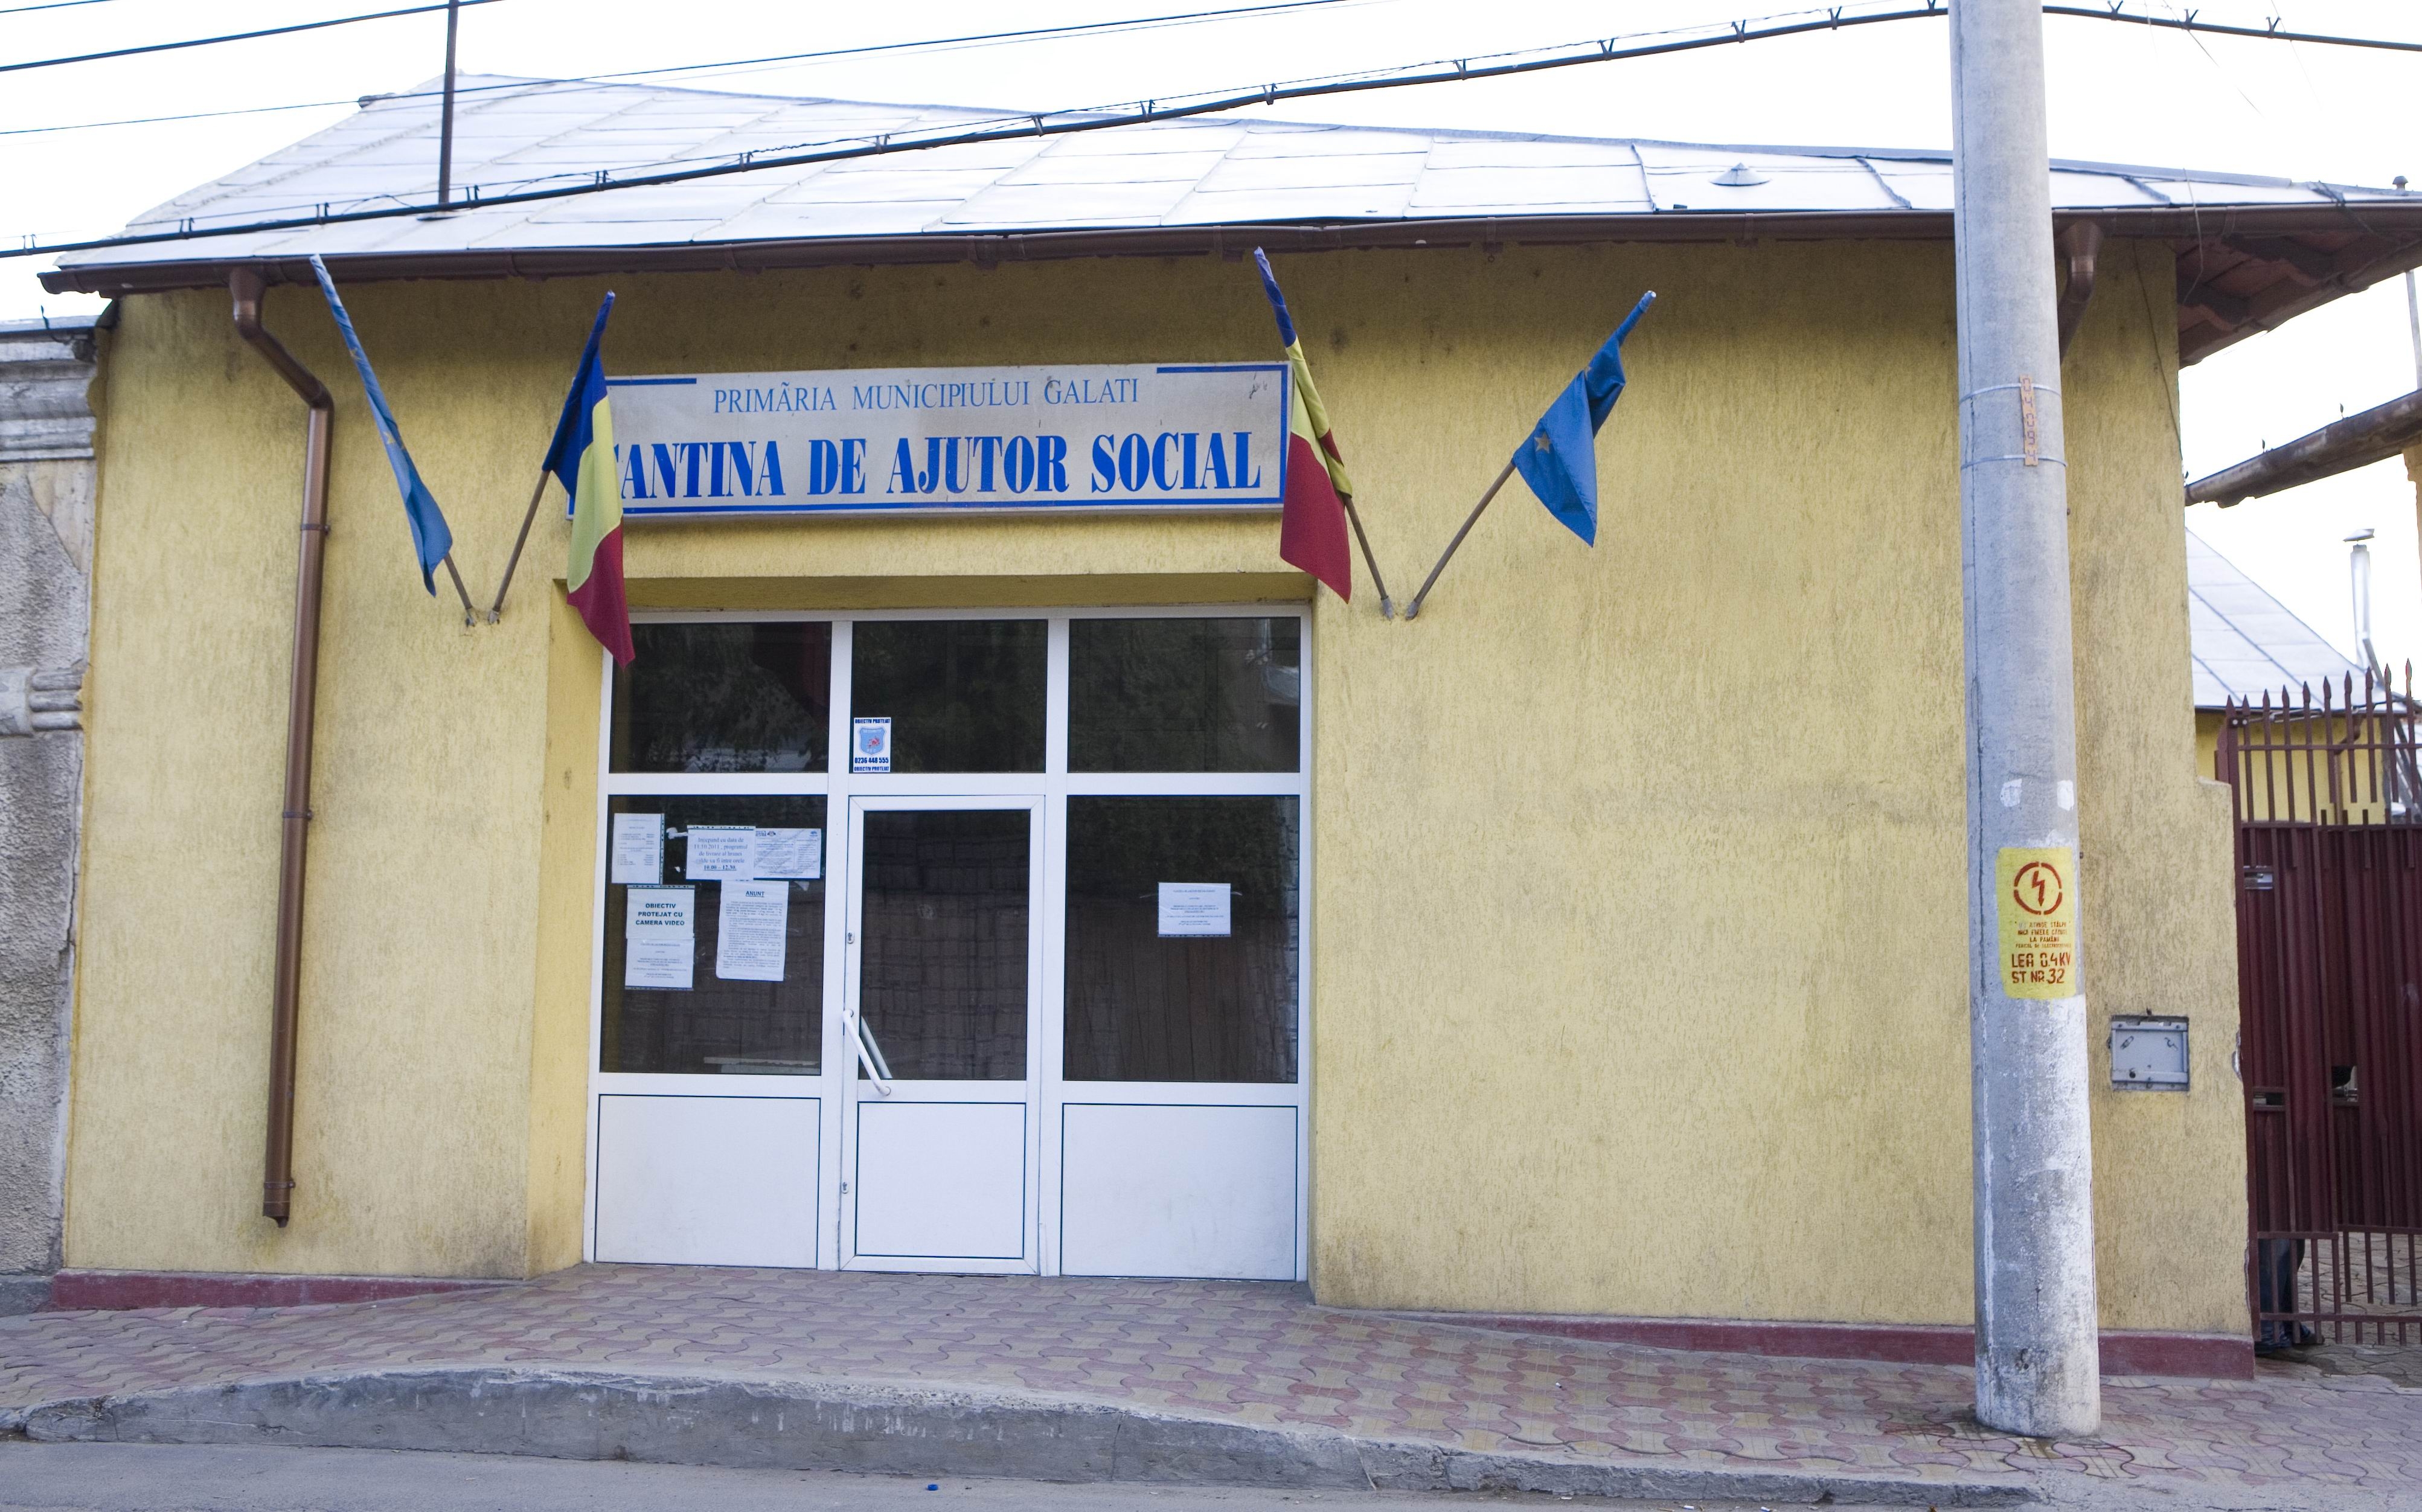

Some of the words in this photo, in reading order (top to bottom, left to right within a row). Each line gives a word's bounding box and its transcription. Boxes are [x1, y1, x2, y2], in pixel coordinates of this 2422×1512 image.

[852, 381, 1030, 410] MUNICIPIULUI
[1044, 378, 1139, 405] GALATI
[614, 440, 786, 499] ANTINA
[807, 438, 866, 496] DE
[886, 434, 1069, 495] AJUTOR
[1091, 431, 1261, 493] SOCIAL
[2011, 953, 2034, 967] LEA
[2011, 970, 2026, 984] ST
